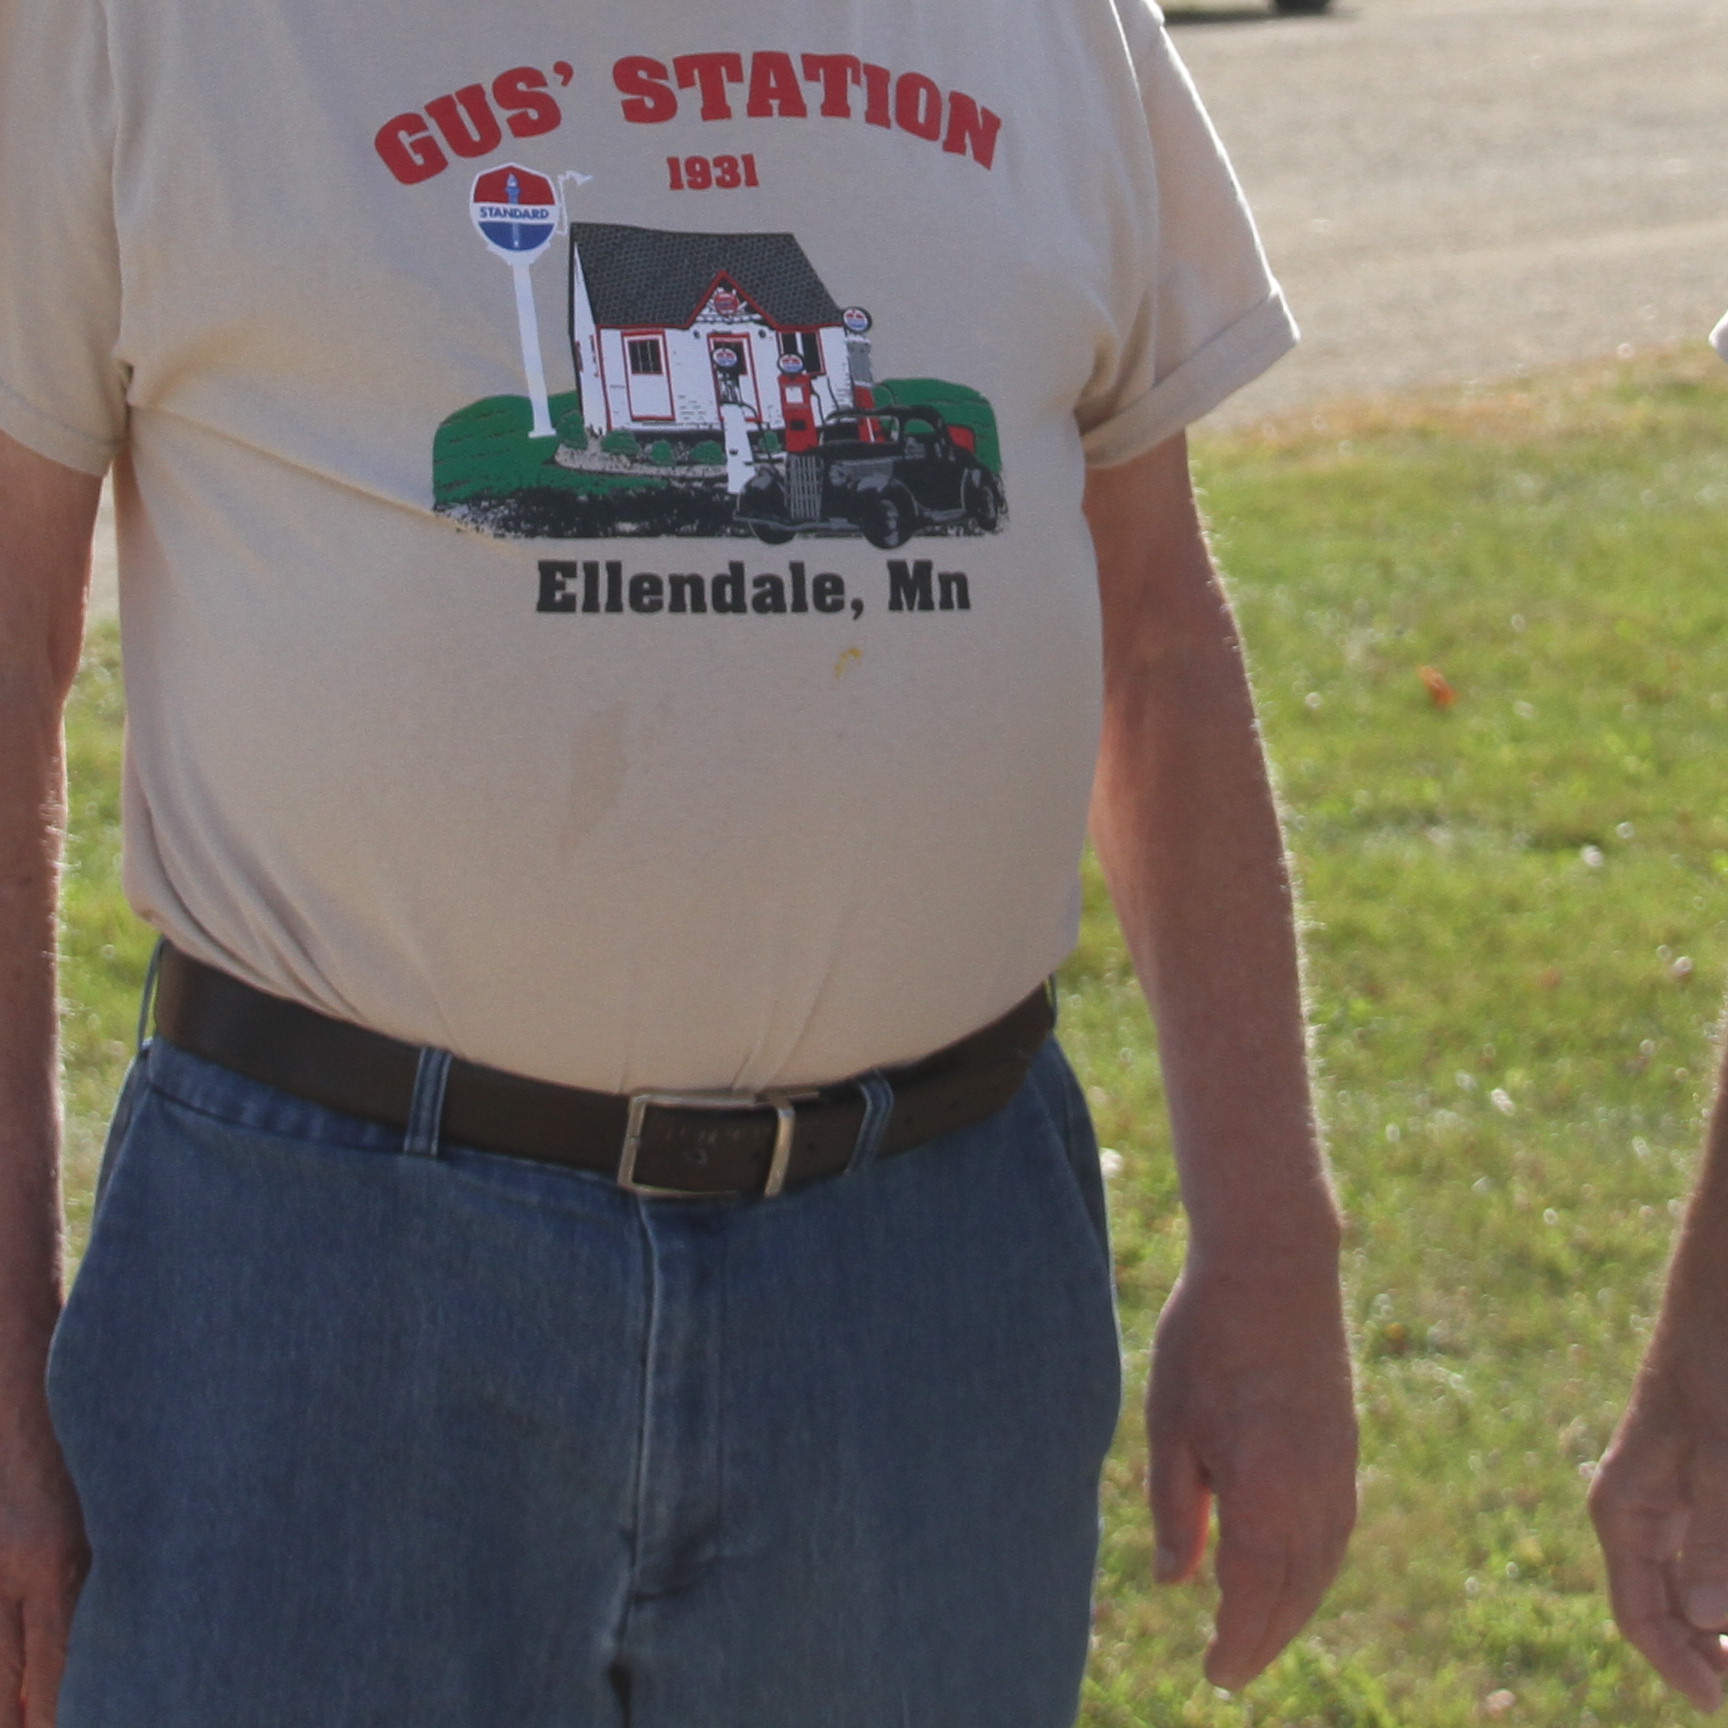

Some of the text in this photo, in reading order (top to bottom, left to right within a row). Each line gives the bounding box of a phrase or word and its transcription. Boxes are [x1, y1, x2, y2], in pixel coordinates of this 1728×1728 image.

[373, 50, 1002, 186] GUS' STATION
[668, 153, 760, 191] 1931
[480, 206, 549, 220] STANDARD
[536, 558, 971, 620] Ellendale, Mn
